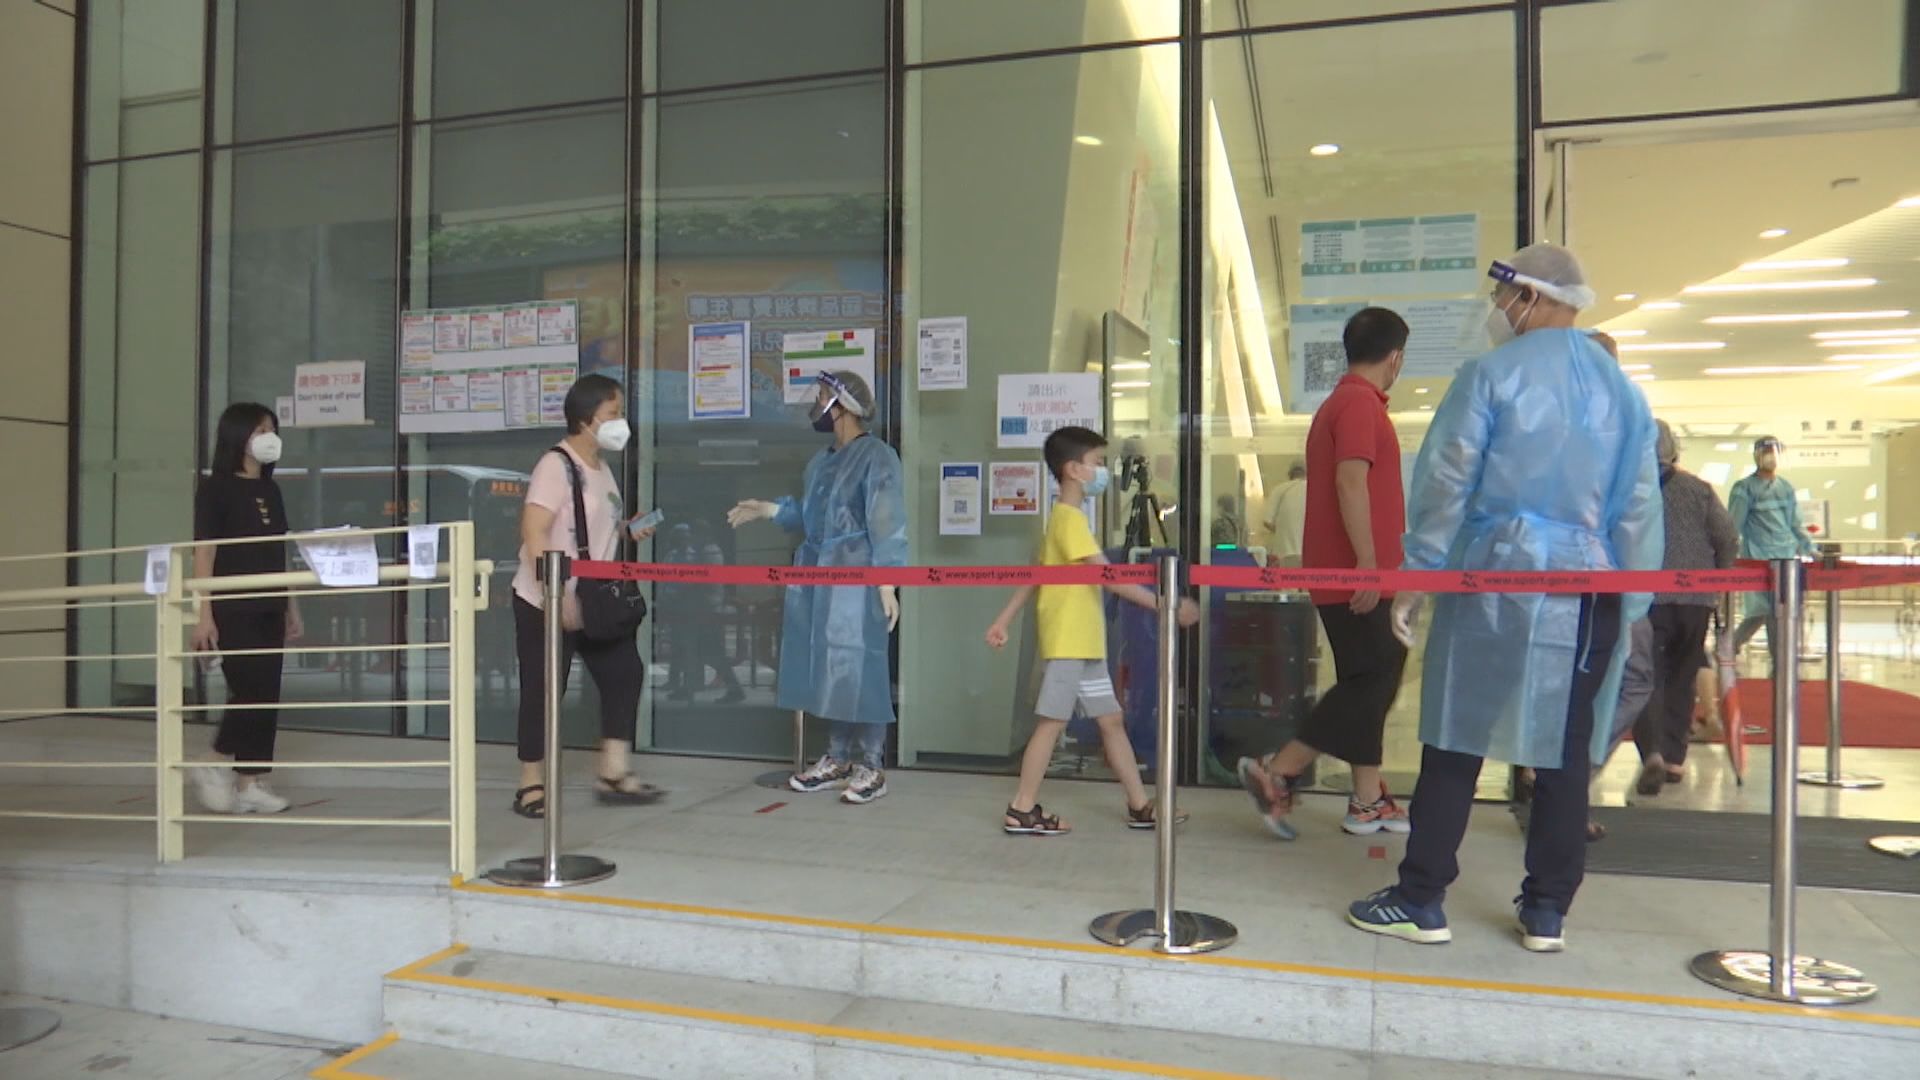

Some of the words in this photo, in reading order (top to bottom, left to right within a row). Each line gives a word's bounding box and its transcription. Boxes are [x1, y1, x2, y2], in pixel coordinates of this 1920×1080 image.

[1028, 384, 1066, 397] 請出示
[635, 567, 709, 578] www.sport.gov.mo
[784, 570, 864, 580] www.sport.gov.mo
[945, 570, 1032, 581] www.sport.gov.mo
[1280, 573, 1381, 585] www.sport.gov.mo
[1483, 575, 1591, 587] www.sport.gov.mo
